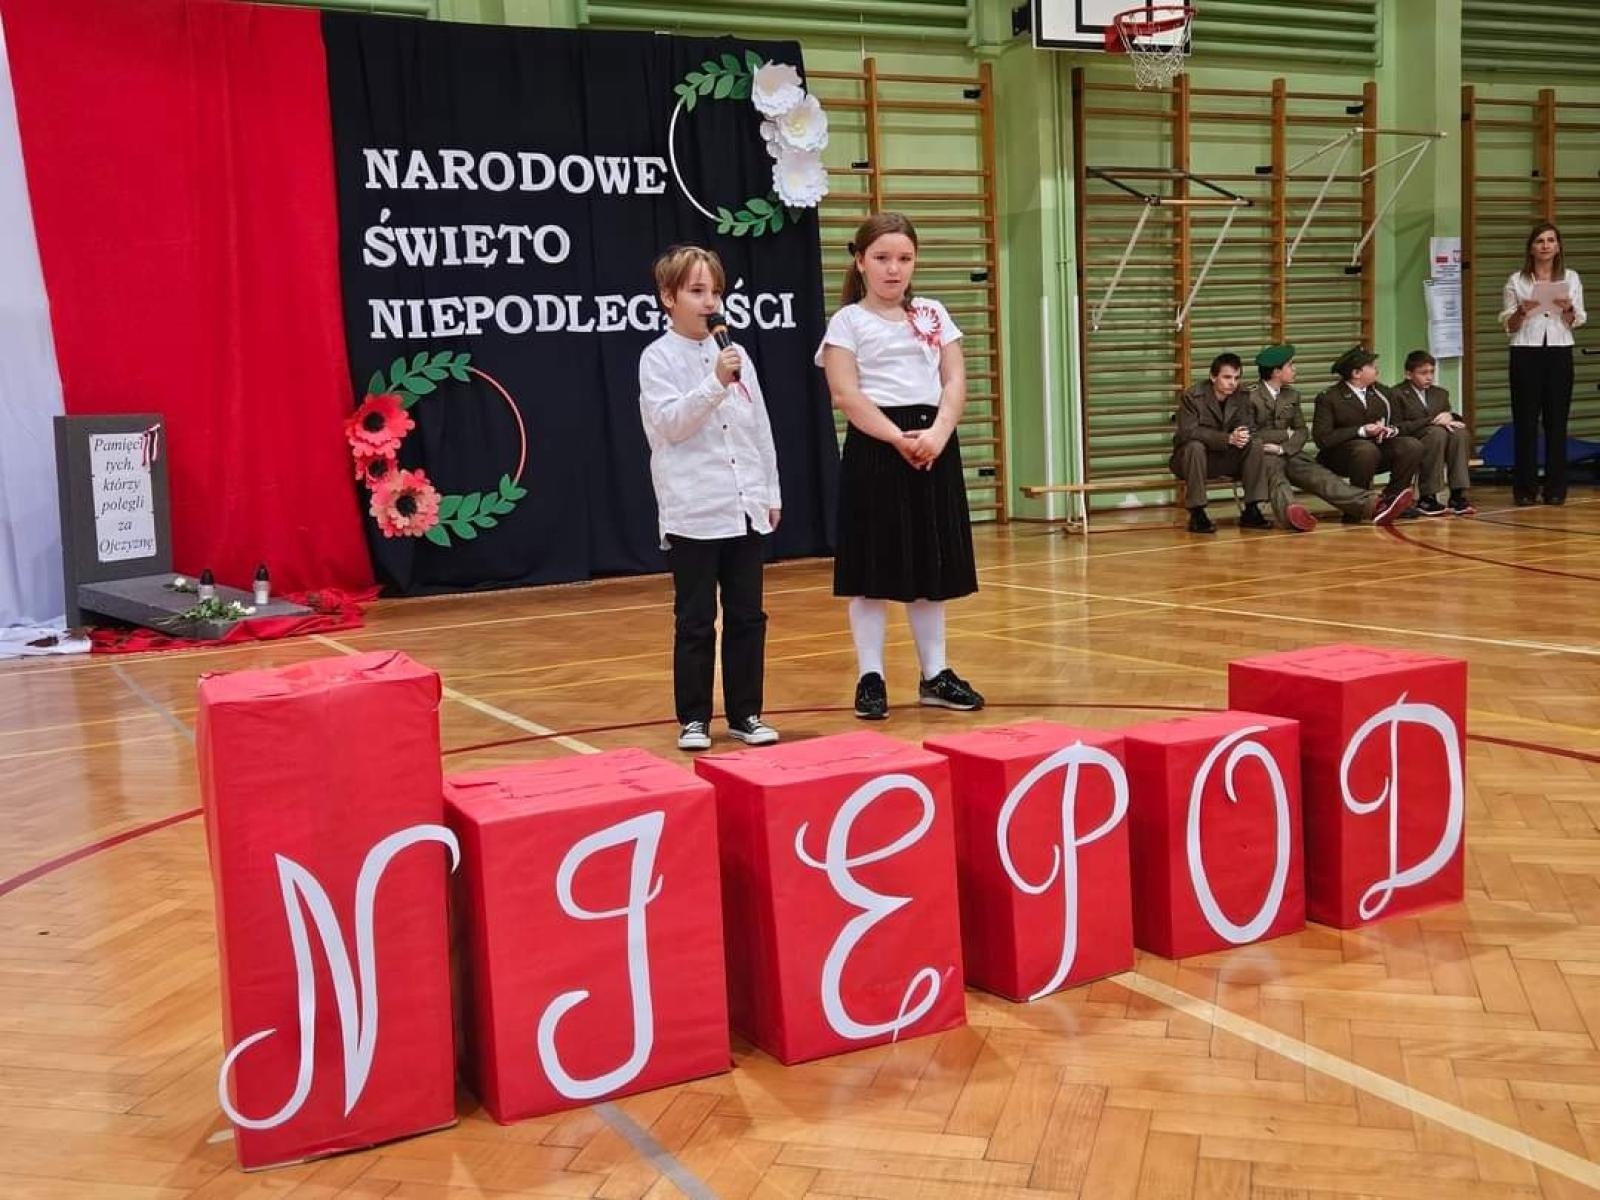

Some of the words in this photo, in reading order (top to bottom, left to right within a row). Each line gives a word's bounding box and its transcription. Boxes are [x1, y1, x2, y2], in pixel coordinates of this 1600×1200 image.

[363, 148, 667, 194] NARODOWE
[362, 208, 571, 268] ŚWIĘTO
[369, 278, 797, 339] NIEPODLEGŚCI
[94, 438, 143, 454] Pamięci
[103, 478, 141, 493] którzy
[101, 495, 145, 515] polegli
[117, 520, 132, 531] za
[99, 538, 154, 555] Ojczyznę
